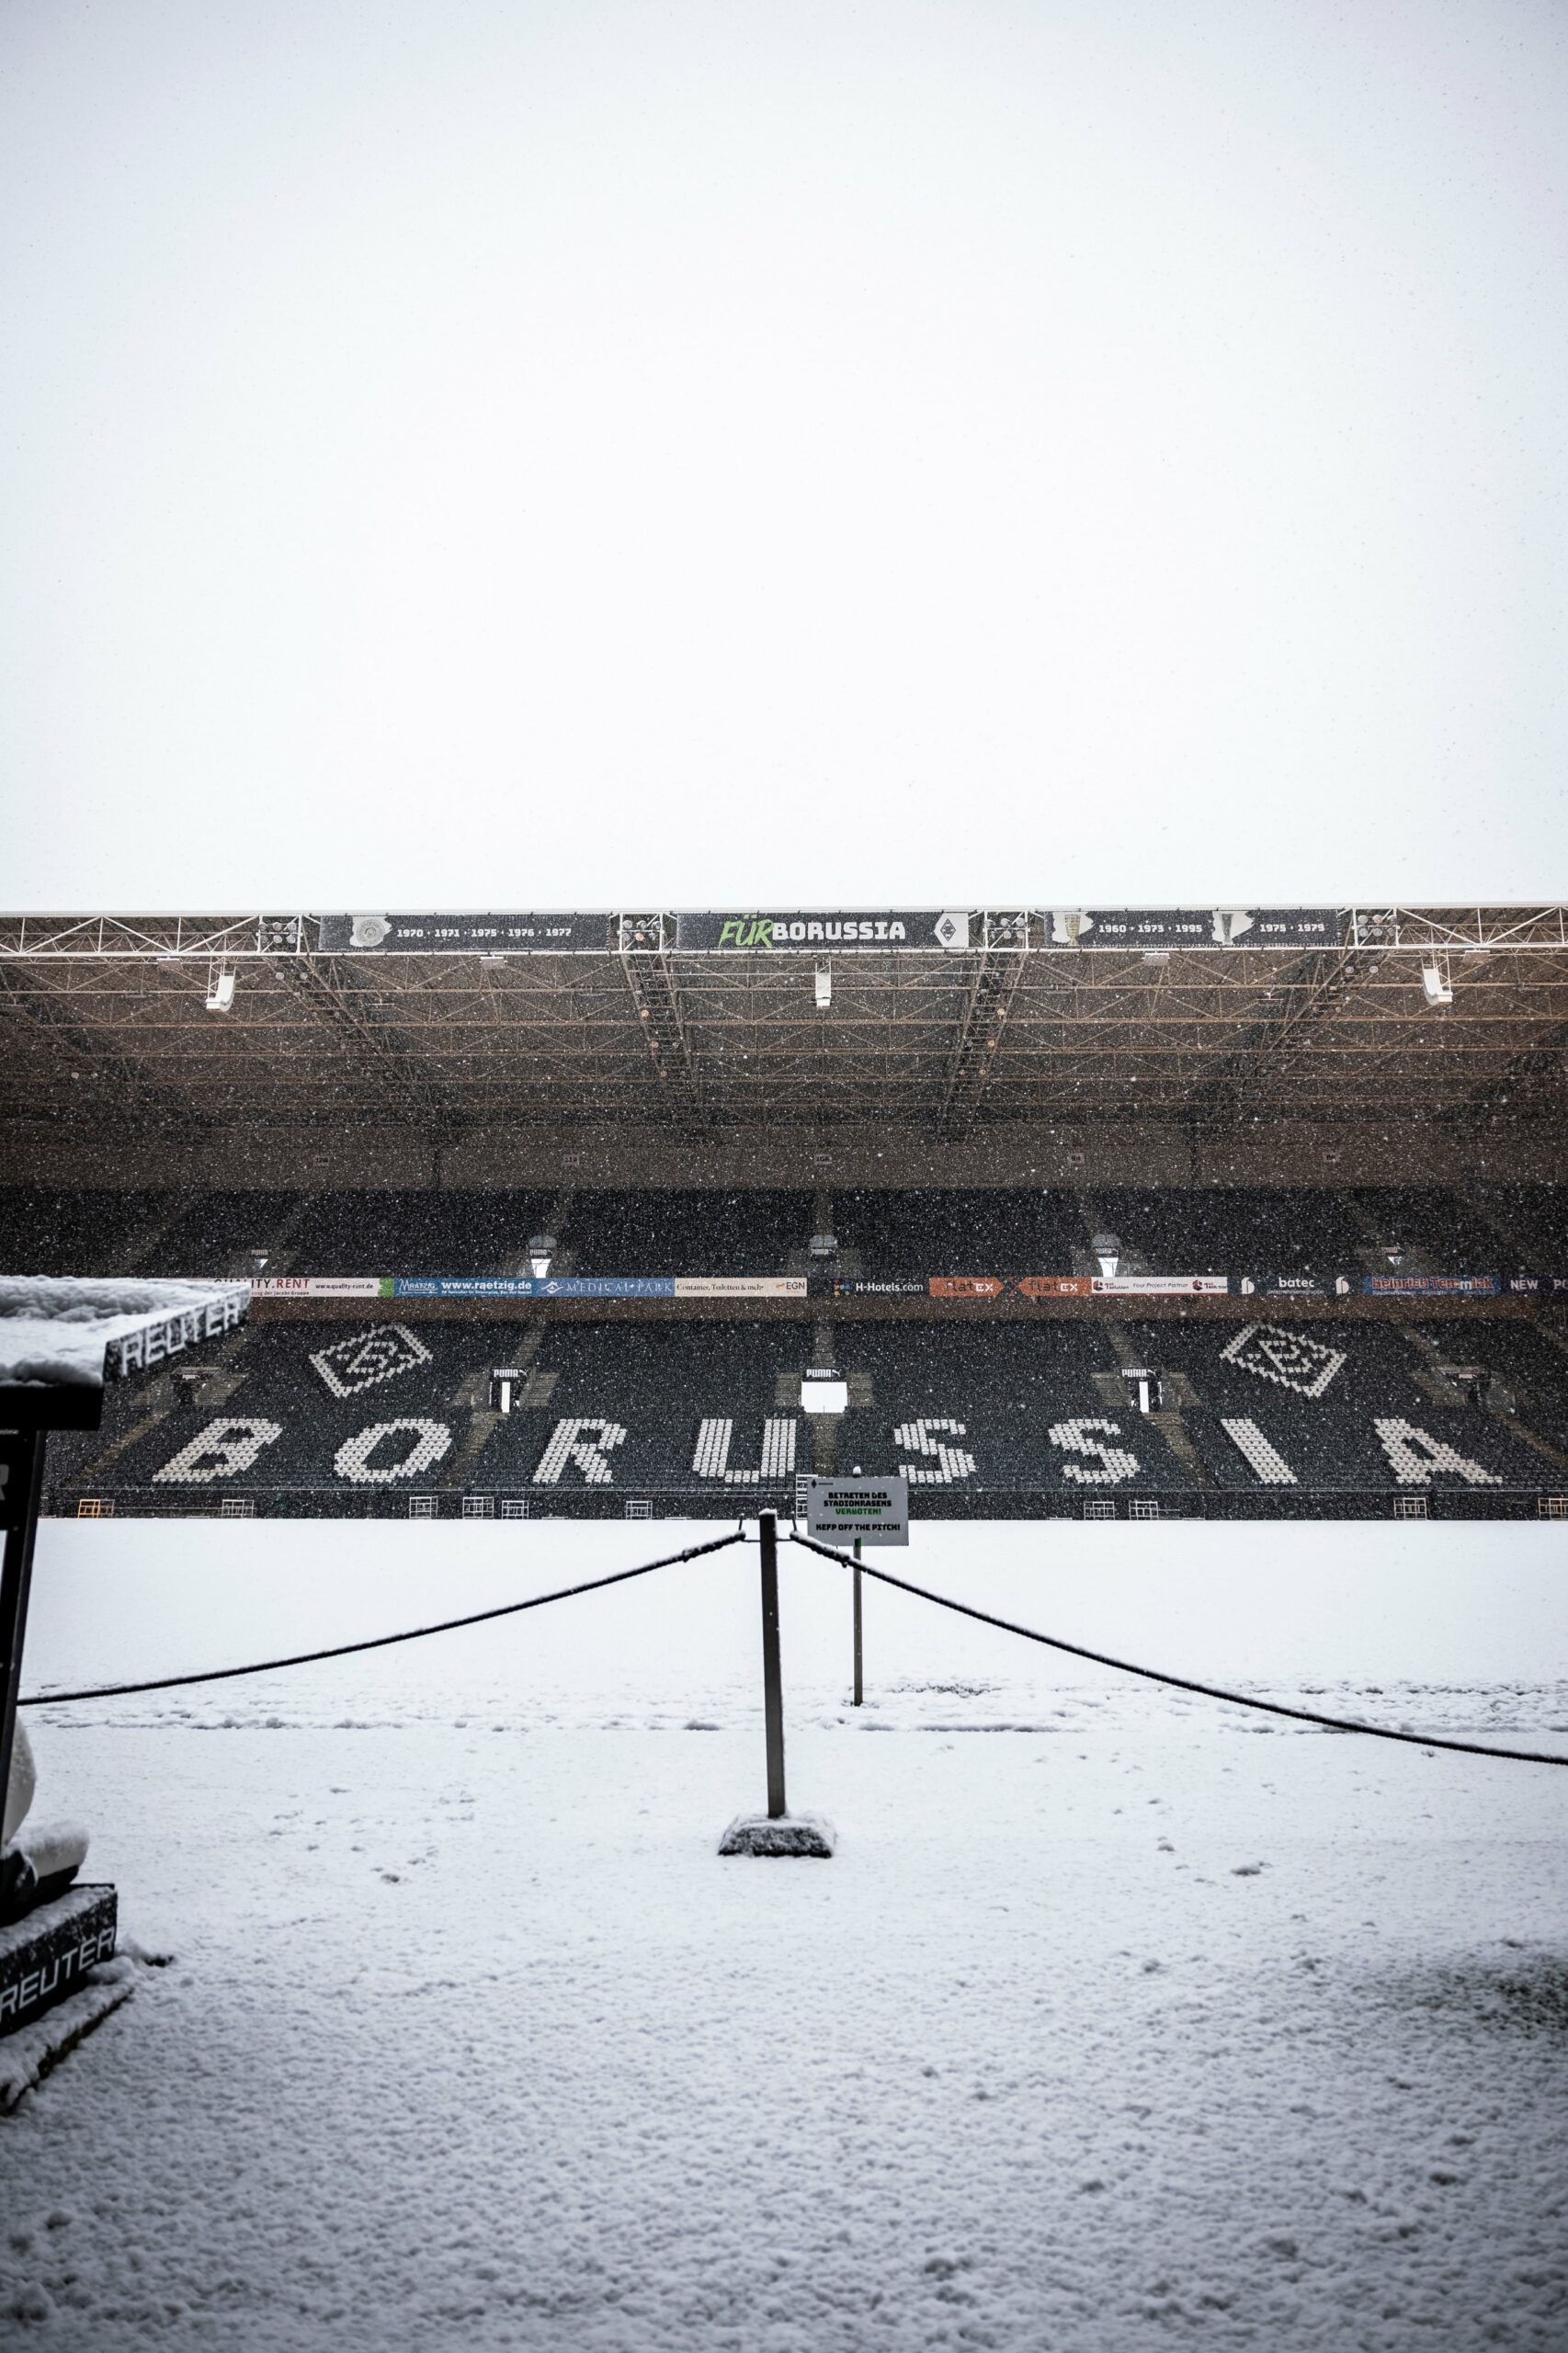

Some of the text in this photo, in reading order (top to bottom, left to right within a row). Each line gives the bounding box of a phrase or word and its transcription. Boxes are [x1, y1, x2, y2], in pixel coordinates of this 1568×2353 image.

[396, 928, 572, 938] 1970 1971 1975 1976 1977
[718, 914, 906, 949] FÜR BORUSSIA
[1098, 924, 1202, 934] 1960 1973 1995
[1260, 923, 1325, 933] 1975 1979
[440, 1280, 532, 1292] www.raetzig.de
[566, 1280, 672, 1292] MEDICAL PARK
[676, 1283, 710, 1291] Container,
[786, 1281, 805, 1290] EGN
[856, 1281, 923, 1292] H-Hotels.com
[1278, 1277, 1315, 1288] batec
[1510, 1279, 1539, 1290] NEW
[121, 1296, 240, 1377] REUTER
[494, 1369, 518, 1378] PUMA
[806, 1369, 832, 1378] PUMA
[1121, 1369, 1147, 1378] PUMA
[837, 1523, 854, 1531] OFF
[854, 1523, 870, 1531] THE
[871, 1523, 901, 1531] PITCH!
[0, 1926, 116, 2020] REUTER
